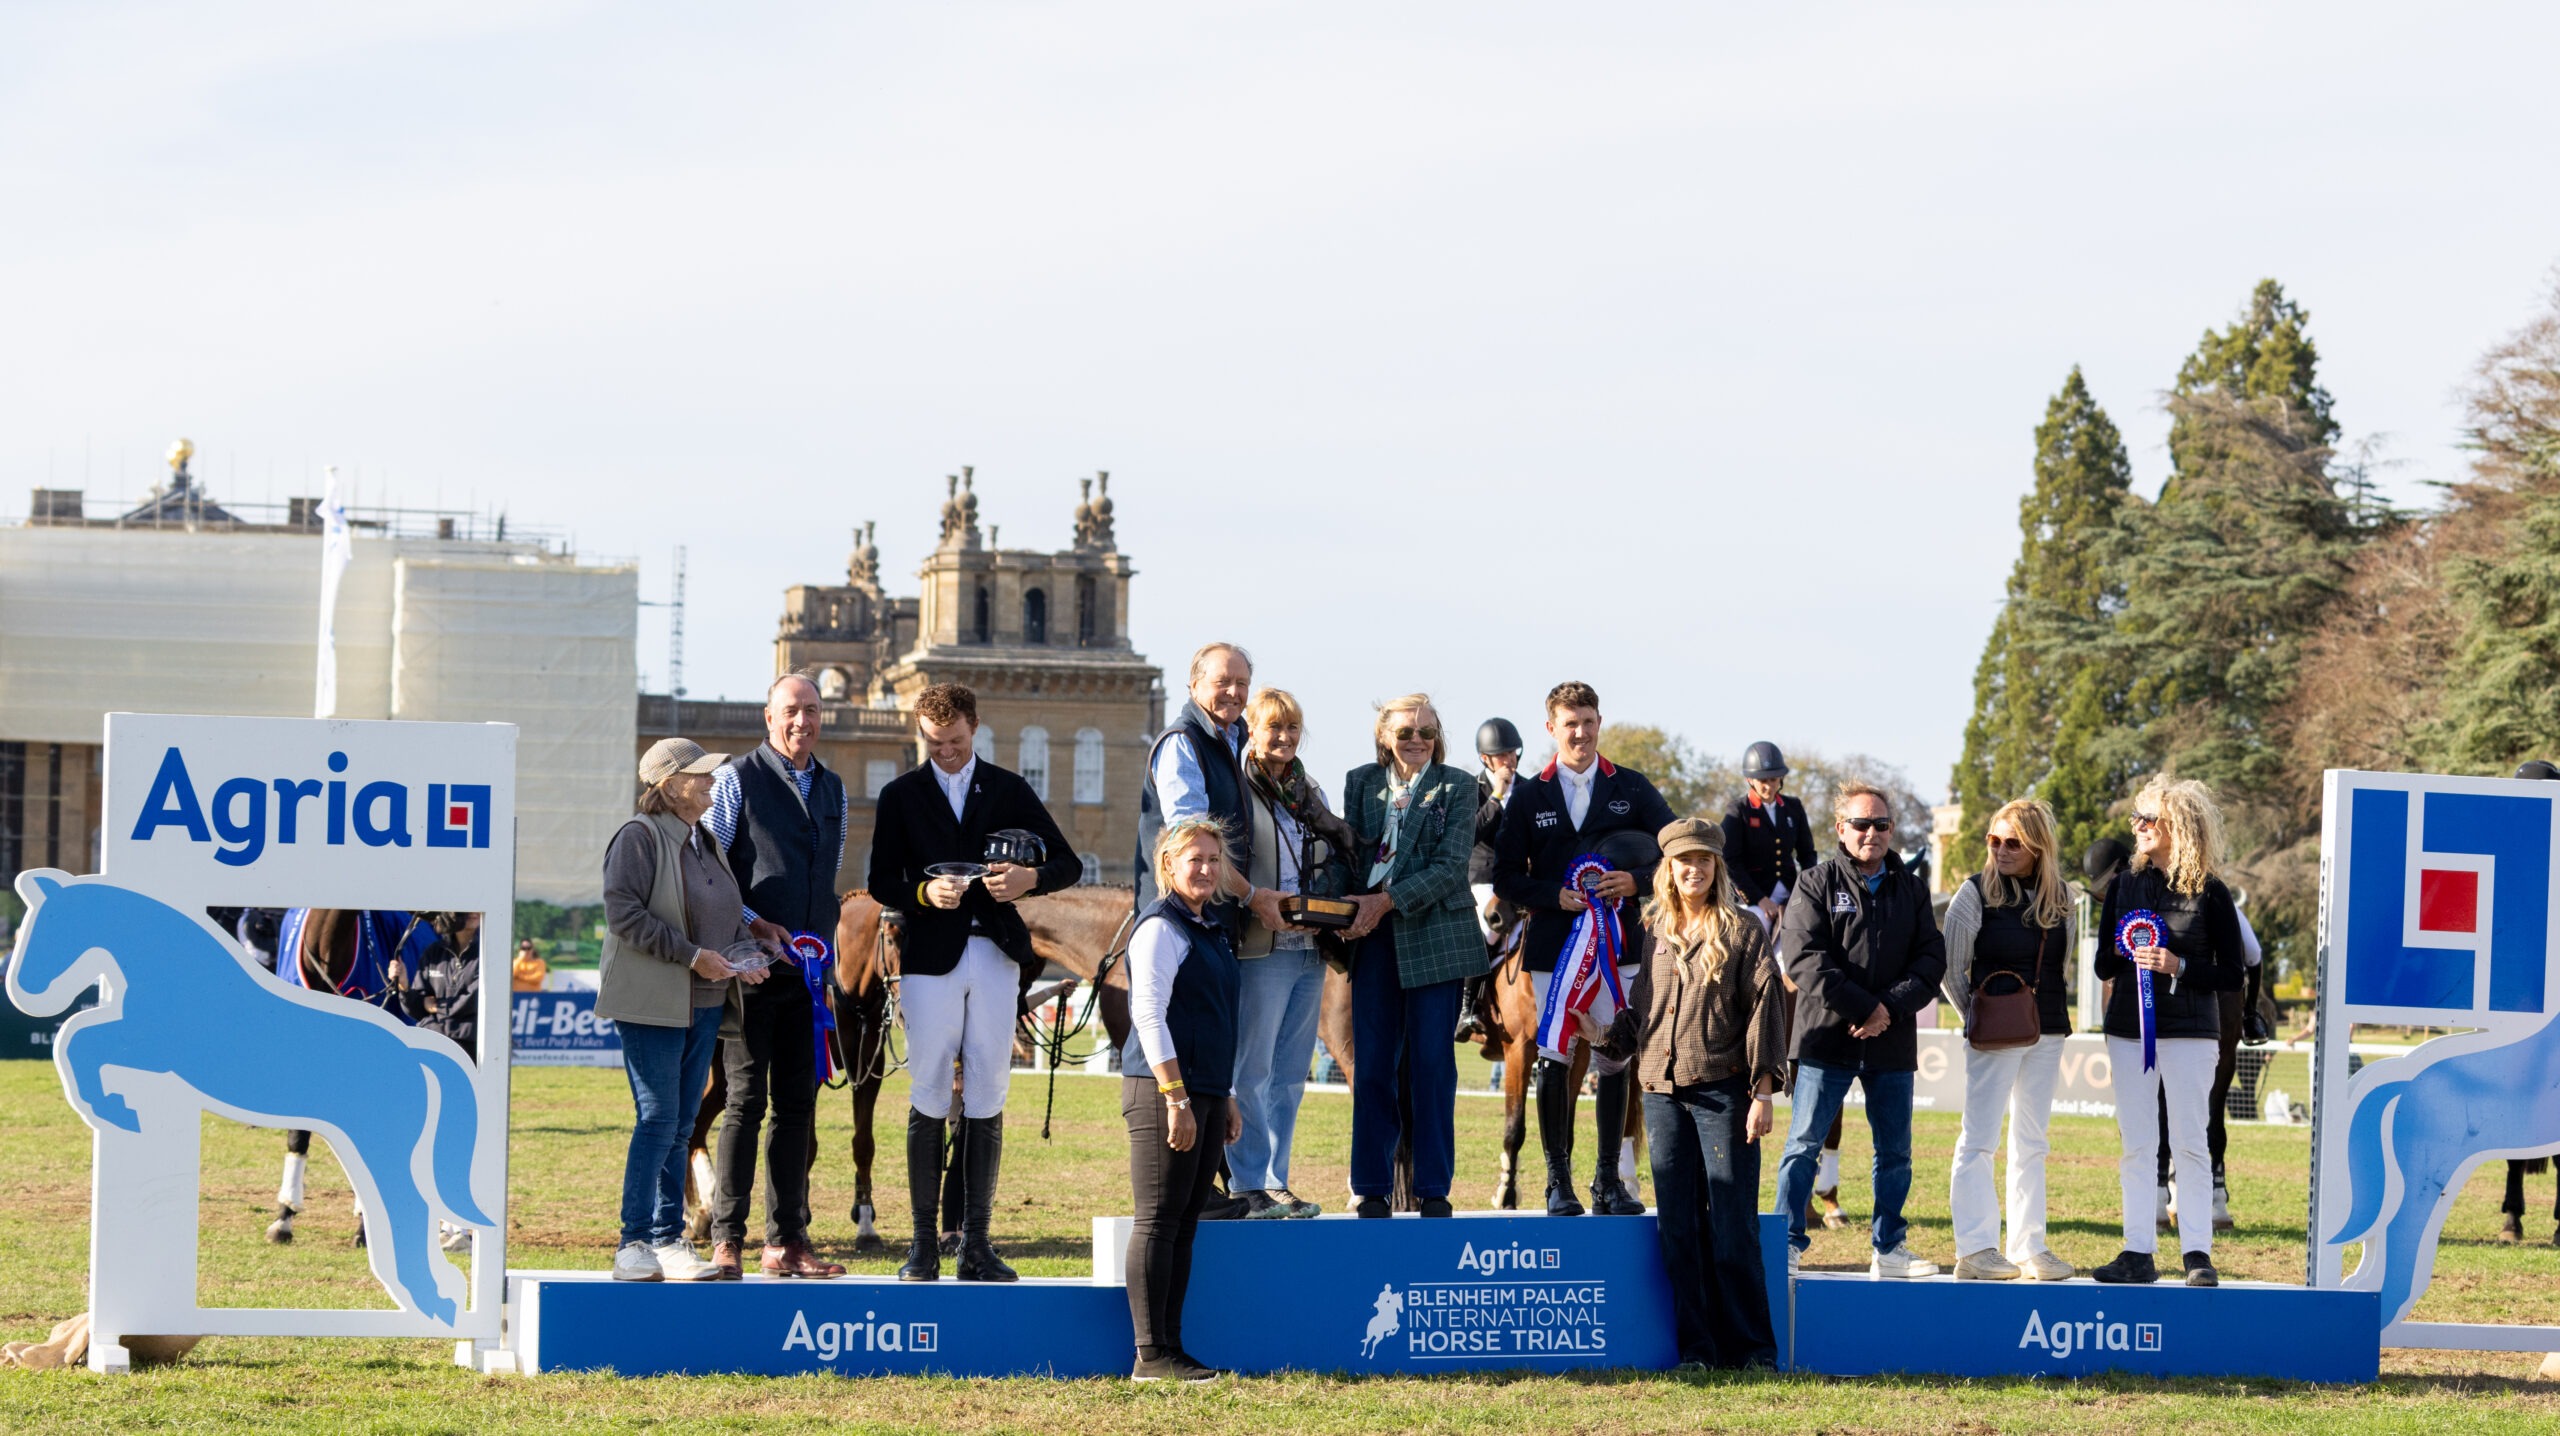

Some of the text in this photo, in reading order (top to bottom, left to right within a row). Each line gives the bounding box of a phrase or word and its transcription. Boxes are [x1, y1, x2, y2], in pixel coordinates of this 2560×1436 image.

[131, 747, 412, 866] Agria
[1536, 817, 1557, 828] YETI
[1837, 892, 1850, 905] B
[1594, 908, 1605, 945] WINNER
[1574, 973, 1586, 990] CCI
[2141, 969, 2153, 1009] SECOND
[573, 1037, 605, 1047] Flakes
[2079, 1100, 2116, 1118] Safety
[1457, 1241, 1537, 1276] Agria
[1408, 1287, 1606, 1306] BLENHEIM PALACE
[1409, 1307, 1606, 1328] INTERNATIONAL
[782, 1310, 903, 1361] Agria
[1409, 1328, 1606, 1352] HORSE TRIALS
[2018, 1309, 2130, 1359] Agria
